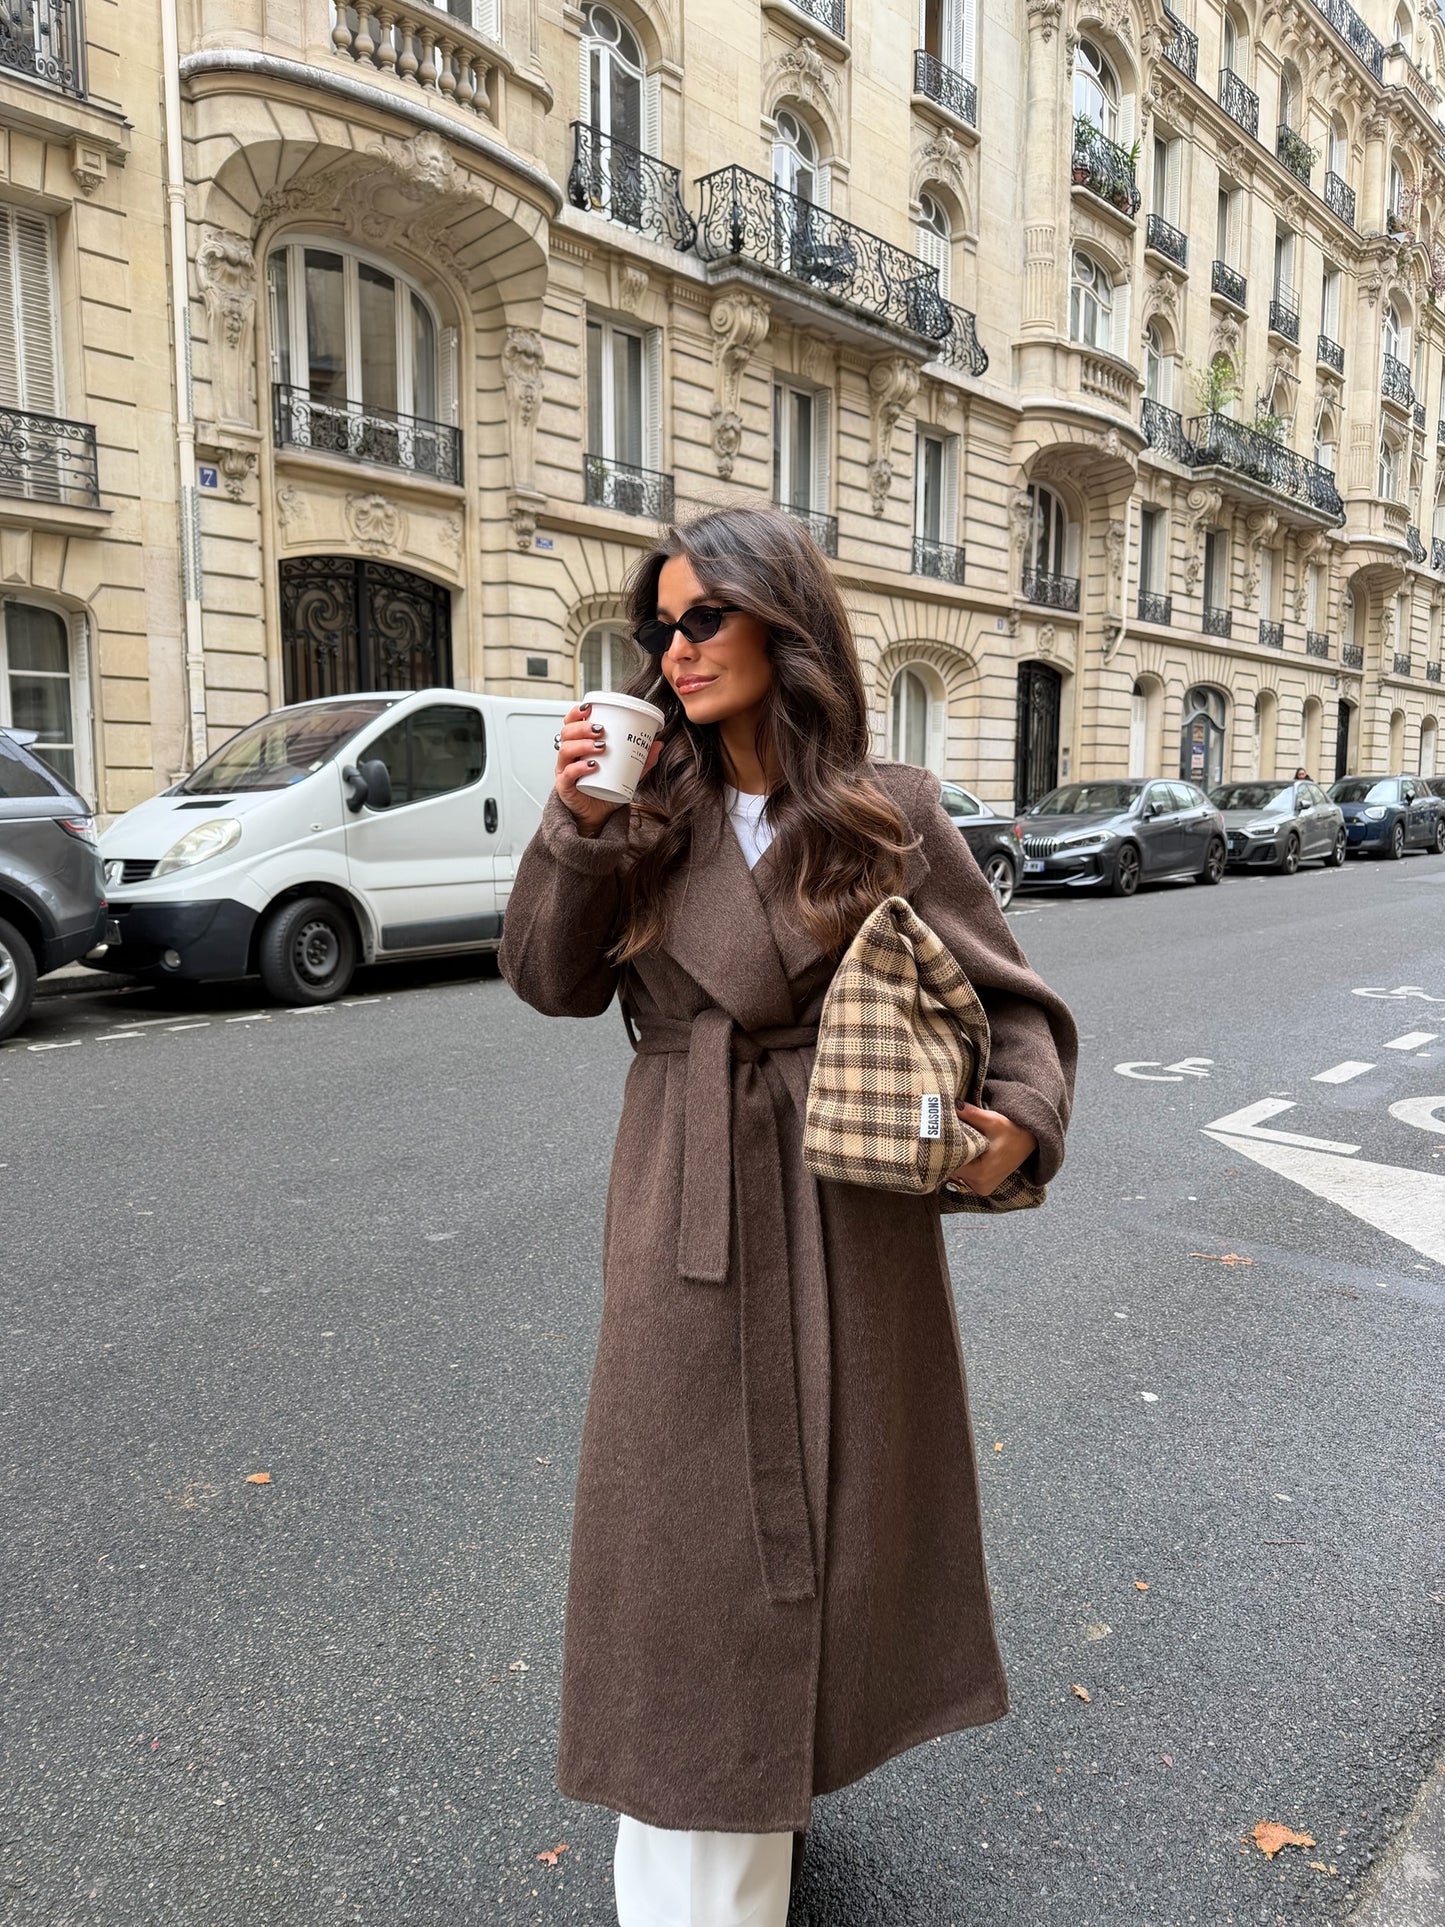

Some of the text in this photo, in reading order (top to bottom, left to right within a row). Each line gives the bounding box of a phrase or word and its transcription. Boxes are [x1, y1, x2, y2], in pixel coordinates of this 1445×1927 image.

[203, 469, 213, 486] 7
[627, 733, 651, 751] RICHA
[928, 1097, 939, 1136] SEASONS
